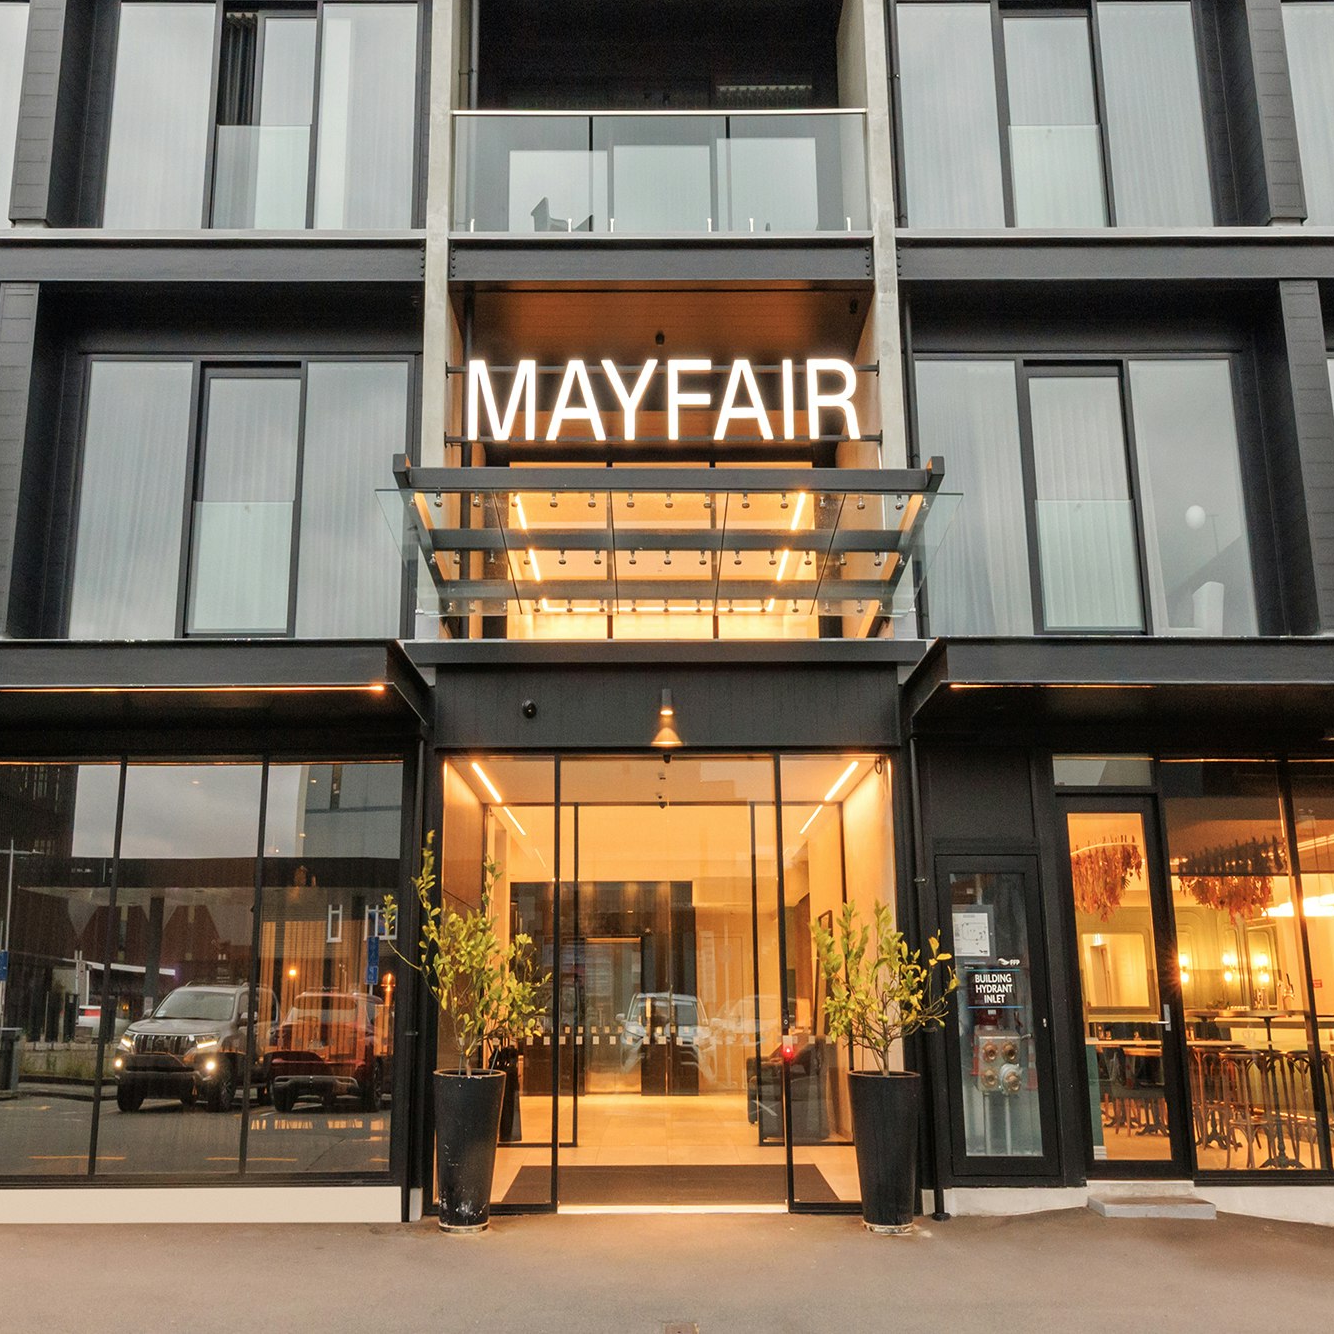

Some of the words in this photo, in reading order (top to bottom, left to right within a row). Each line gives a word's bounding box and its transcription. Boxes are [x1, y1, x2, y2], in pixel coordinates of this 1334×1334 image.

[466, 357, 861, 442] MAYFAIR
[974, 973, 1012, 984] BUILDING
[975, 983, 1013, 994] HYDRANT
[984, 994, 1006, 1004] INLET
